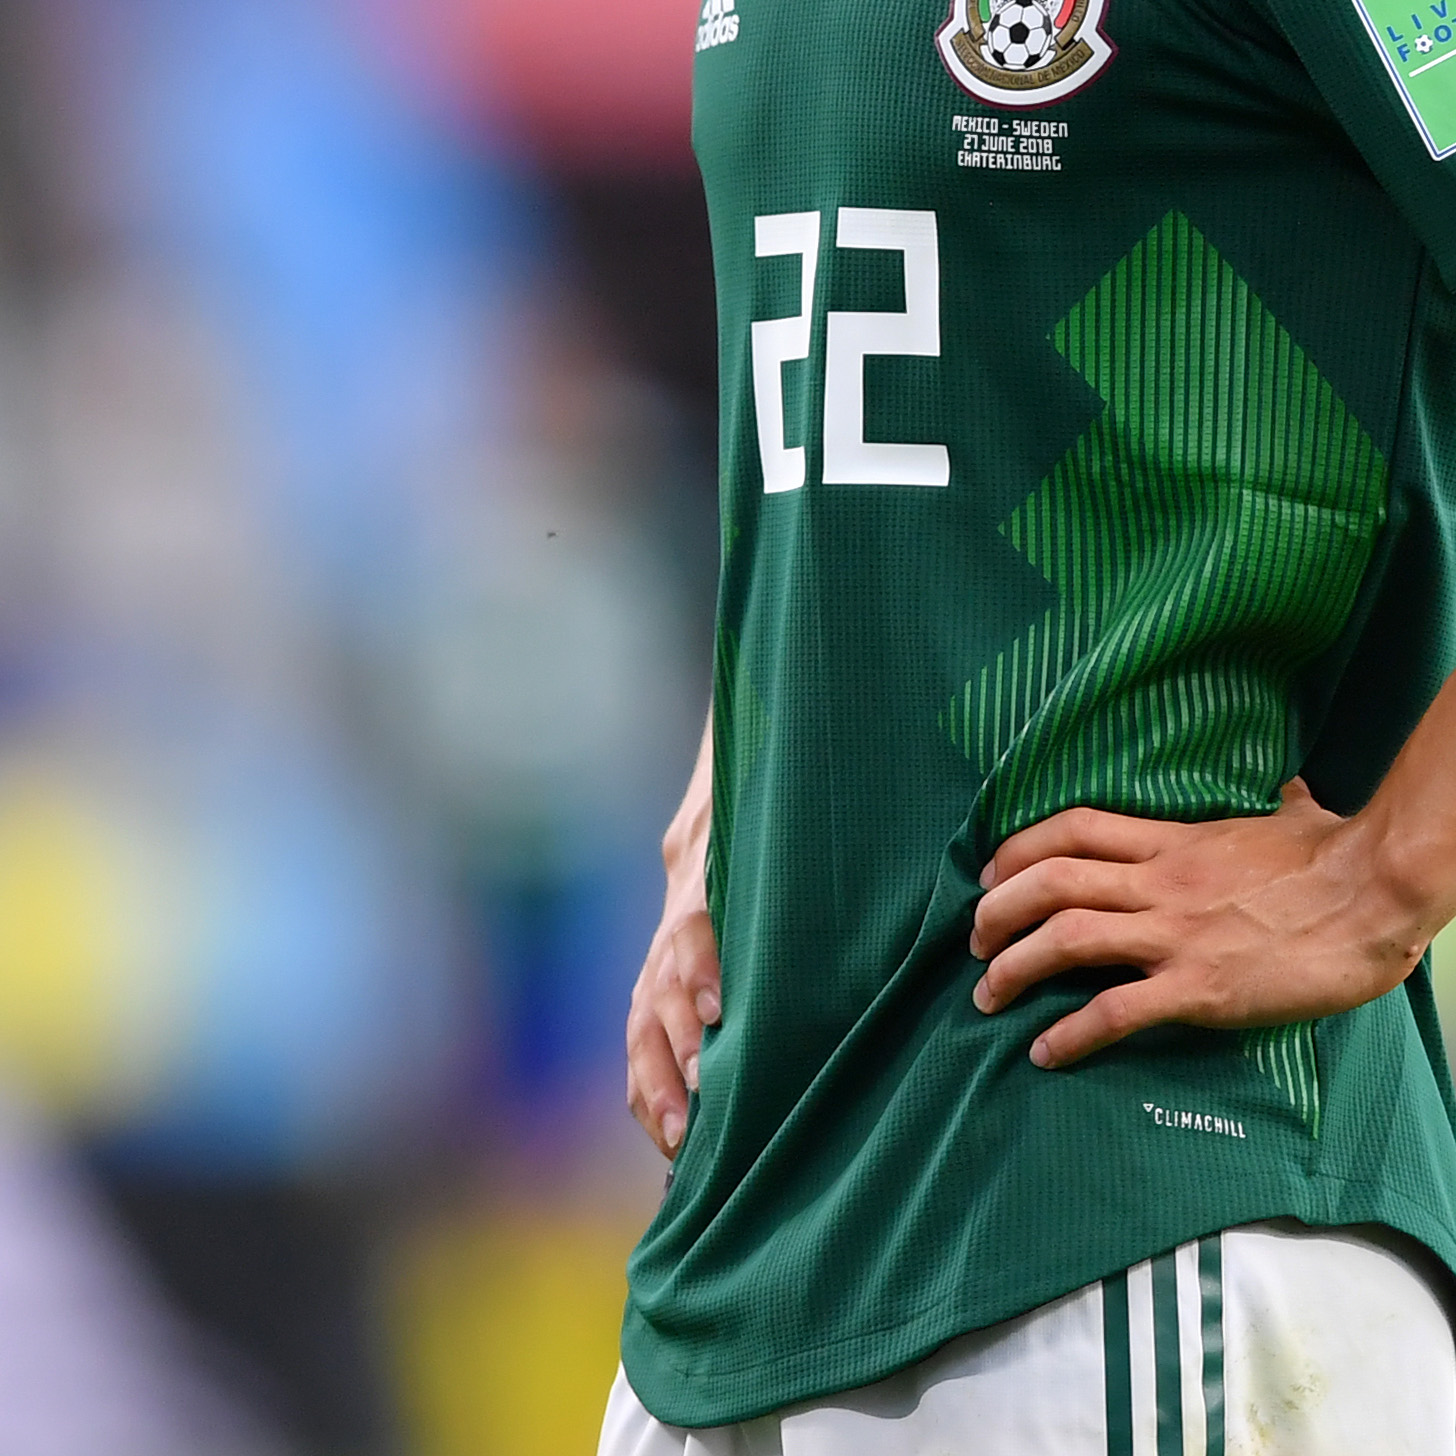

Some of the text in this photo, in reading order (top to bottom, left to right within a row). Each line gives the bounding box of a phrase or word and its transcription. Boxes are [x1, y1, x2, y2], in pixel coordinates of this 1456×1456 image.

[695, 11, 740, 53] adidas
[1037, 71, 1051, 83] DE
[952, 115, 999, 134] MEXICO
[1012, 120, 1069, 138] SWEDEN
[963, 134, 1053, 154] 27 JUNE 2018
[957, 150, 1062, 171] EKATERINBURG
[750, 206, 950, 495] 22
[1154, 1107, 1246, 1139] CLIMACHILL
